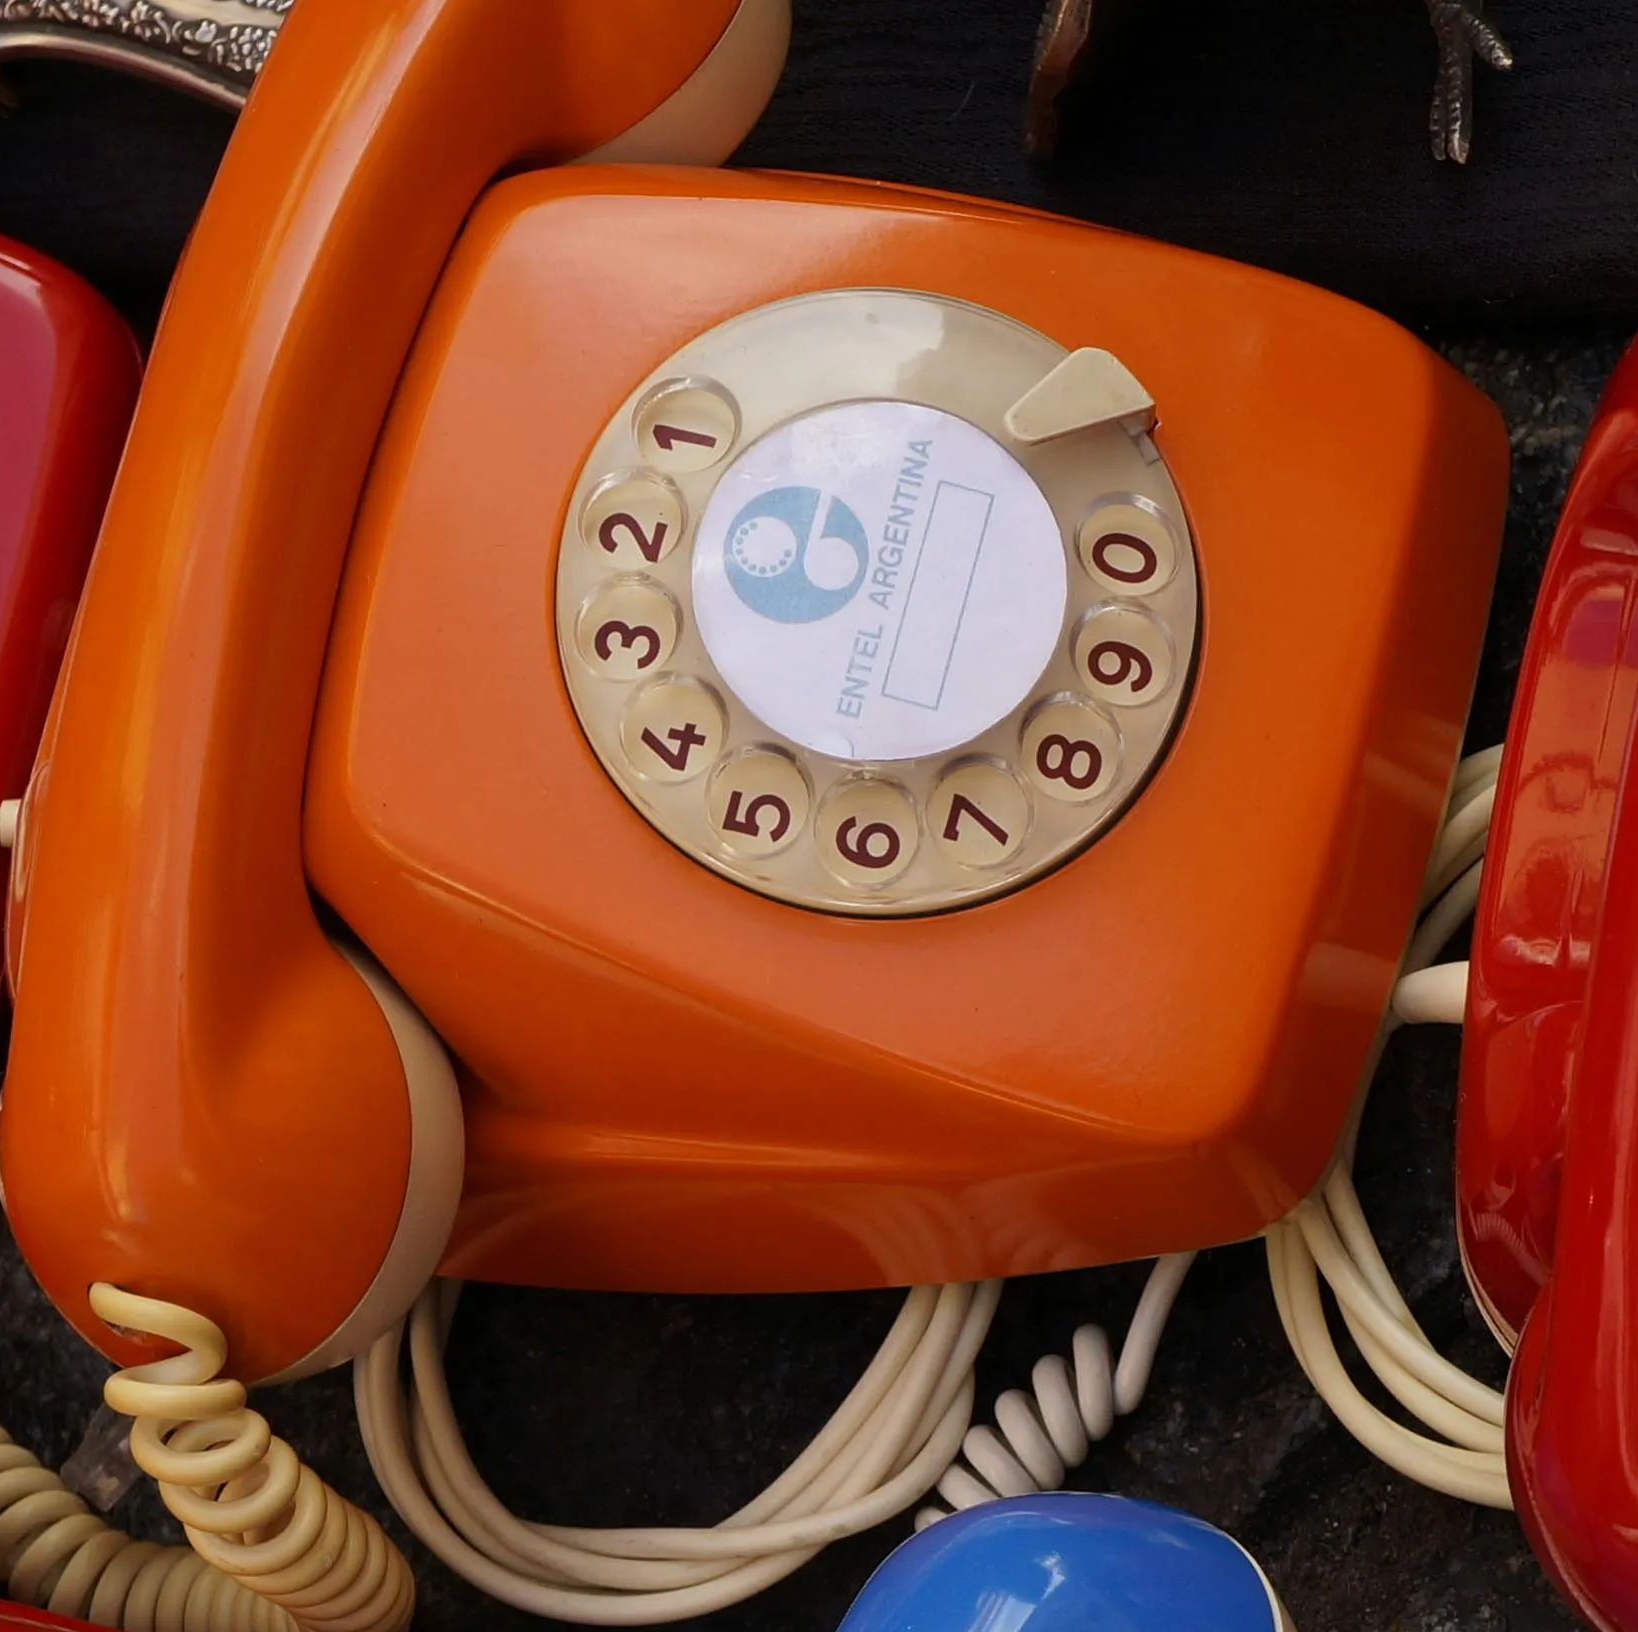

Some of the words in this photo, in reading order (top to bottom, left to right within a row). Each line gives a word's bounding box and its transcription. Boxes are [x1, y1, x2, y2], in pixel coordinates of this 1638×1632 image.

[652, 424, 717, 452] 1
[598, 512, 668, 563] 2
[1092, 533, 1158, 583] 0
[835, 623, 884, 720] ENTEL
[868, 438, 934, 610] ARGENTINA
[594, 620, 661, 669] 3
[1087, 640, 1153, 693] 9
[641, 722, 706, 772] 4
[1035, 734, 1102, 789] 8
[722, 790, 791, 843] 5
[836, 816, 901, 869] 6
[942, 793, 1010, 847] 7
